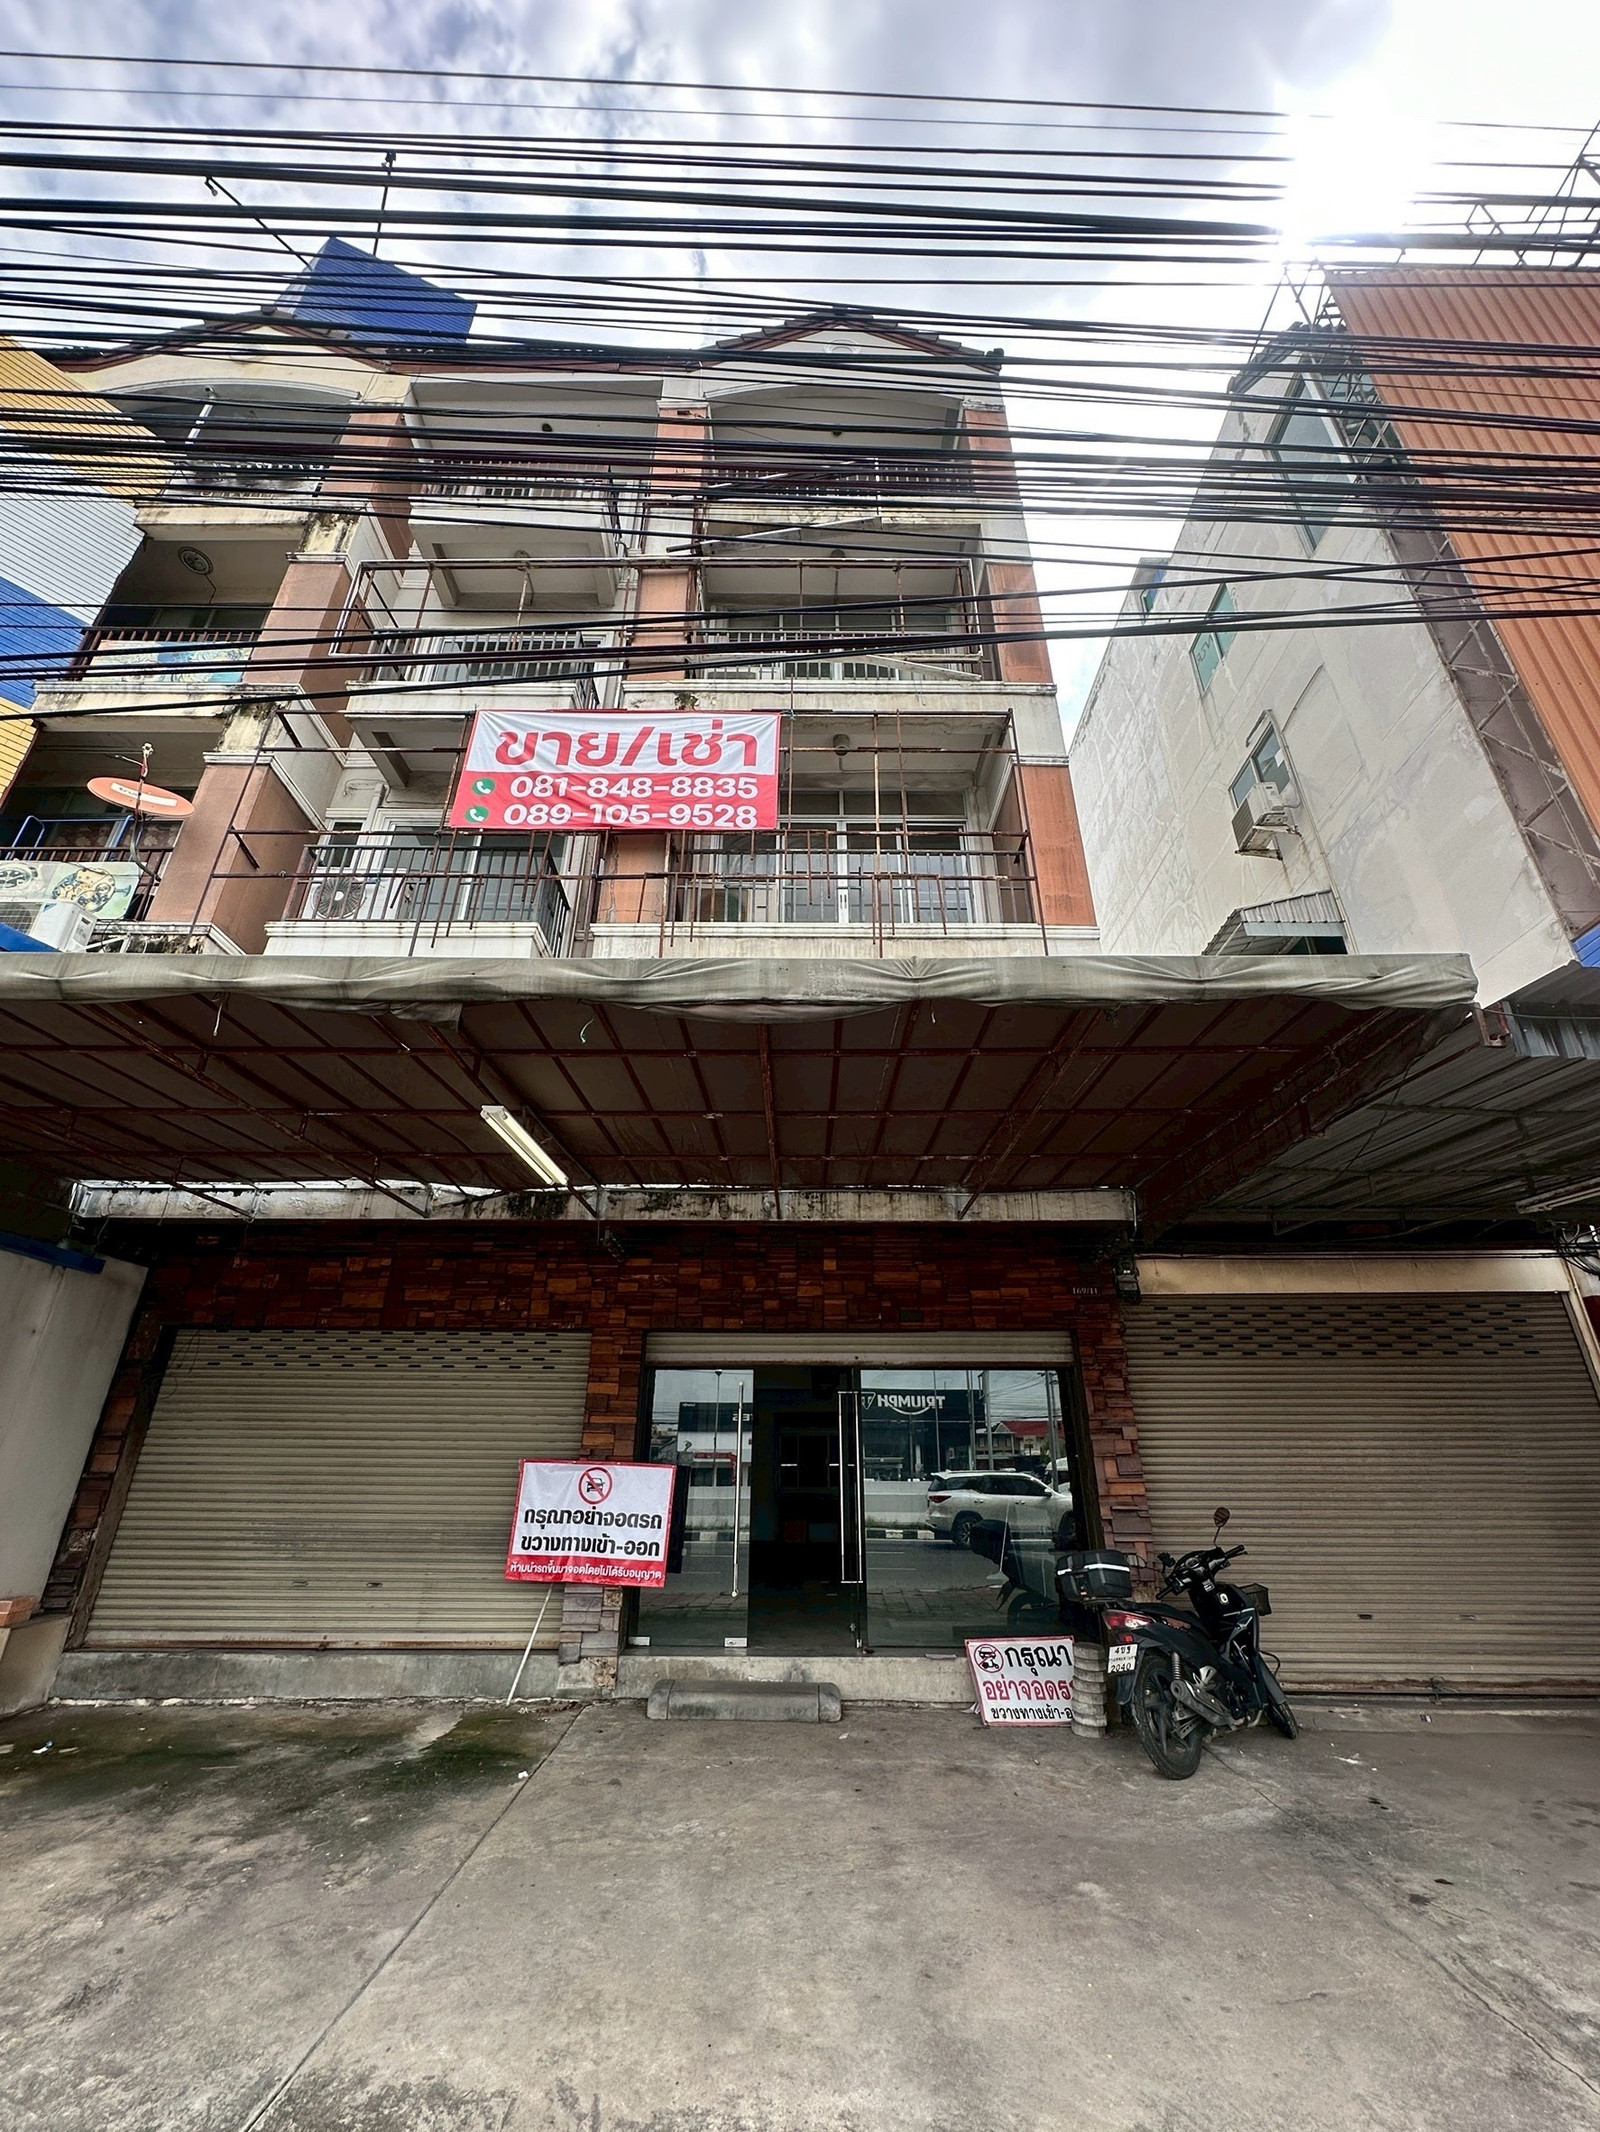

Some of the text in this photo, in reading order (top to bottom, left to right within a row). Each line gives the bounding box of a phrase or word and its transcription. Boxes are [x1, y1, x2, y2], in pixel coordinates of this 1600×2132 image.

[495, 718, 758, 767] ขาย/เช่า
[510, 775, 758, 799] 081-848-8835
[503, 803, 758, 828] 089-105-9528
[523, 1506, 663, 1530] กรุณาอย่าจอดรถ
[520, 1533, 660, 1557] ขวางทางเข้า-ออก
[1004, 1645, 1073, 1676] กรุณา
[982, 1674, 1074, 1701] อย่าจอดร
